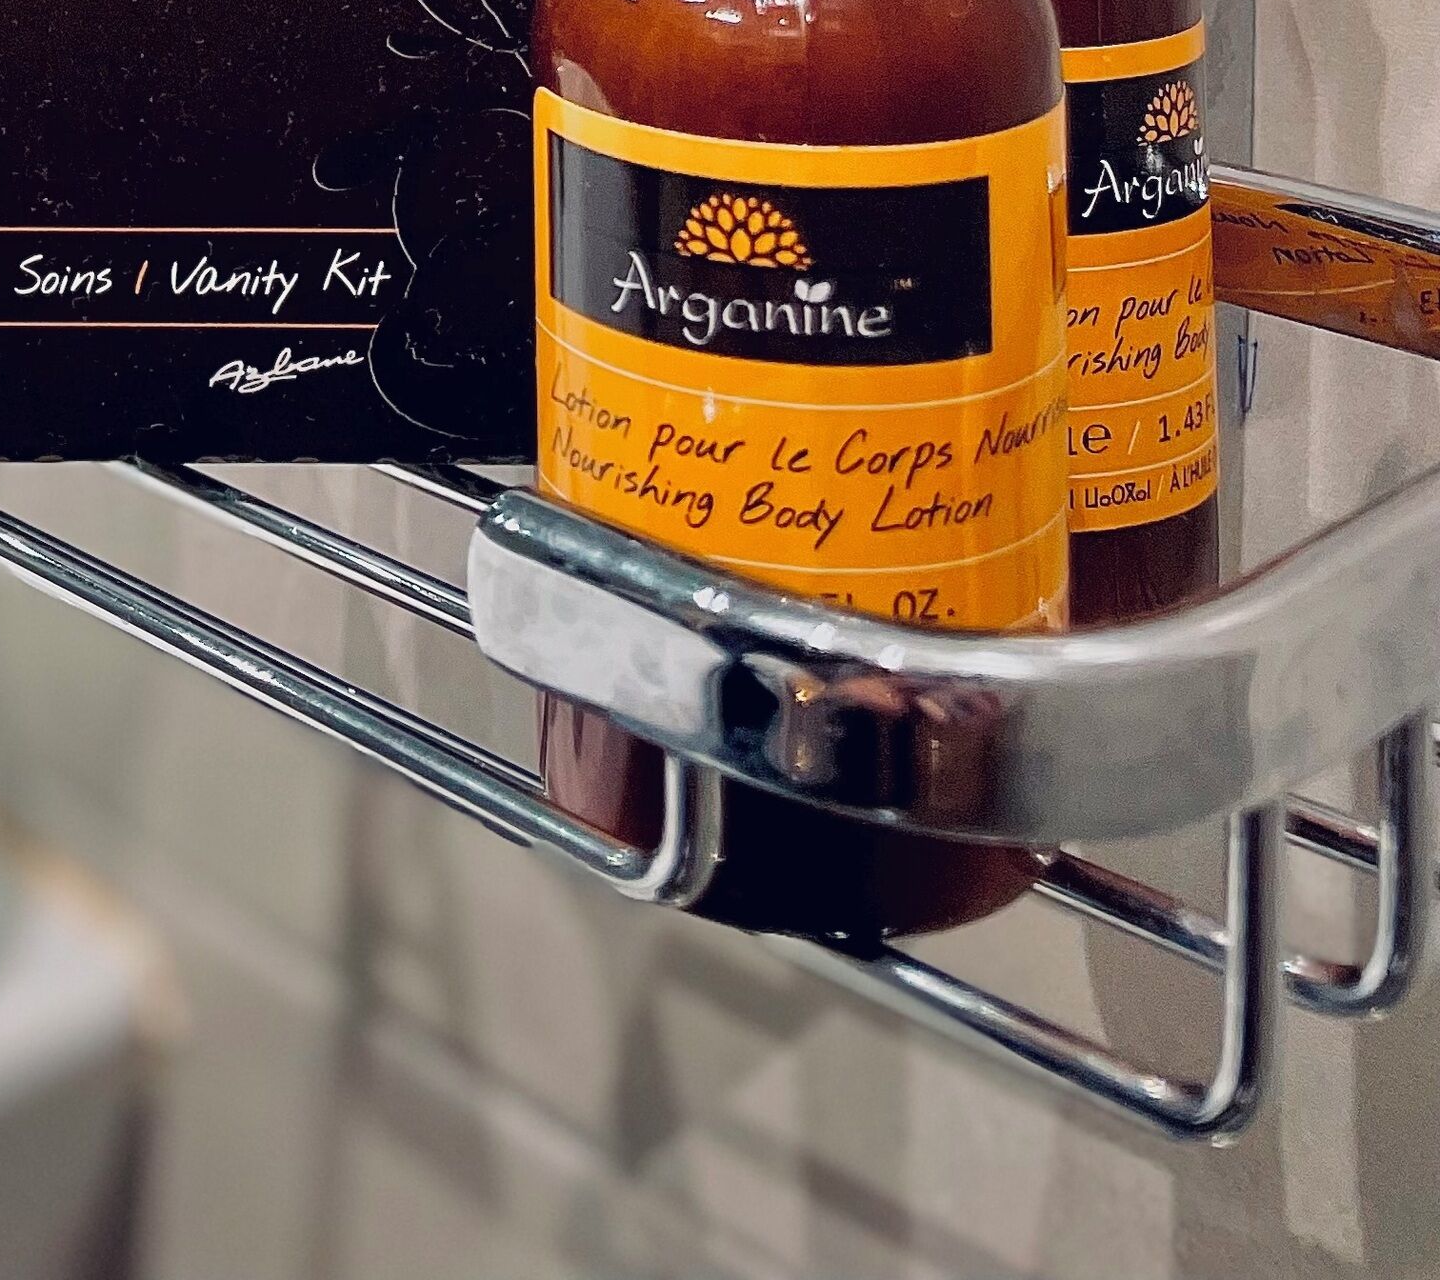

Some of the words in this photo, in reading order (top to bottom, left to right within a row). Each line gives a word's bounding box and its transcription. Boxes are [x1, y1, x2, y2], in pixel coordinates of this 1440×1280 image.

[13, 253, 113, 296] Soins
[169, 256, 300, 315] Vanity
[322, 248, 392, 298] Kit
[610, 250, 894, 346] Arganine
[1114, 288, 1179, 340] pour
[1067, 335, 1162, 380] rishing
[551, 359, 632, 439] Lotion
[648, 423, 746, 463] pour
[771, 436, 811, 473] le
[834, 427, 953, 490] Corps
[1157, 400, 1203, 443] 1.43
[551, 426, 715, 529] Nourishing
[738, 480, 845, 551] Body
[870, 483, 993, 532] Lotion
